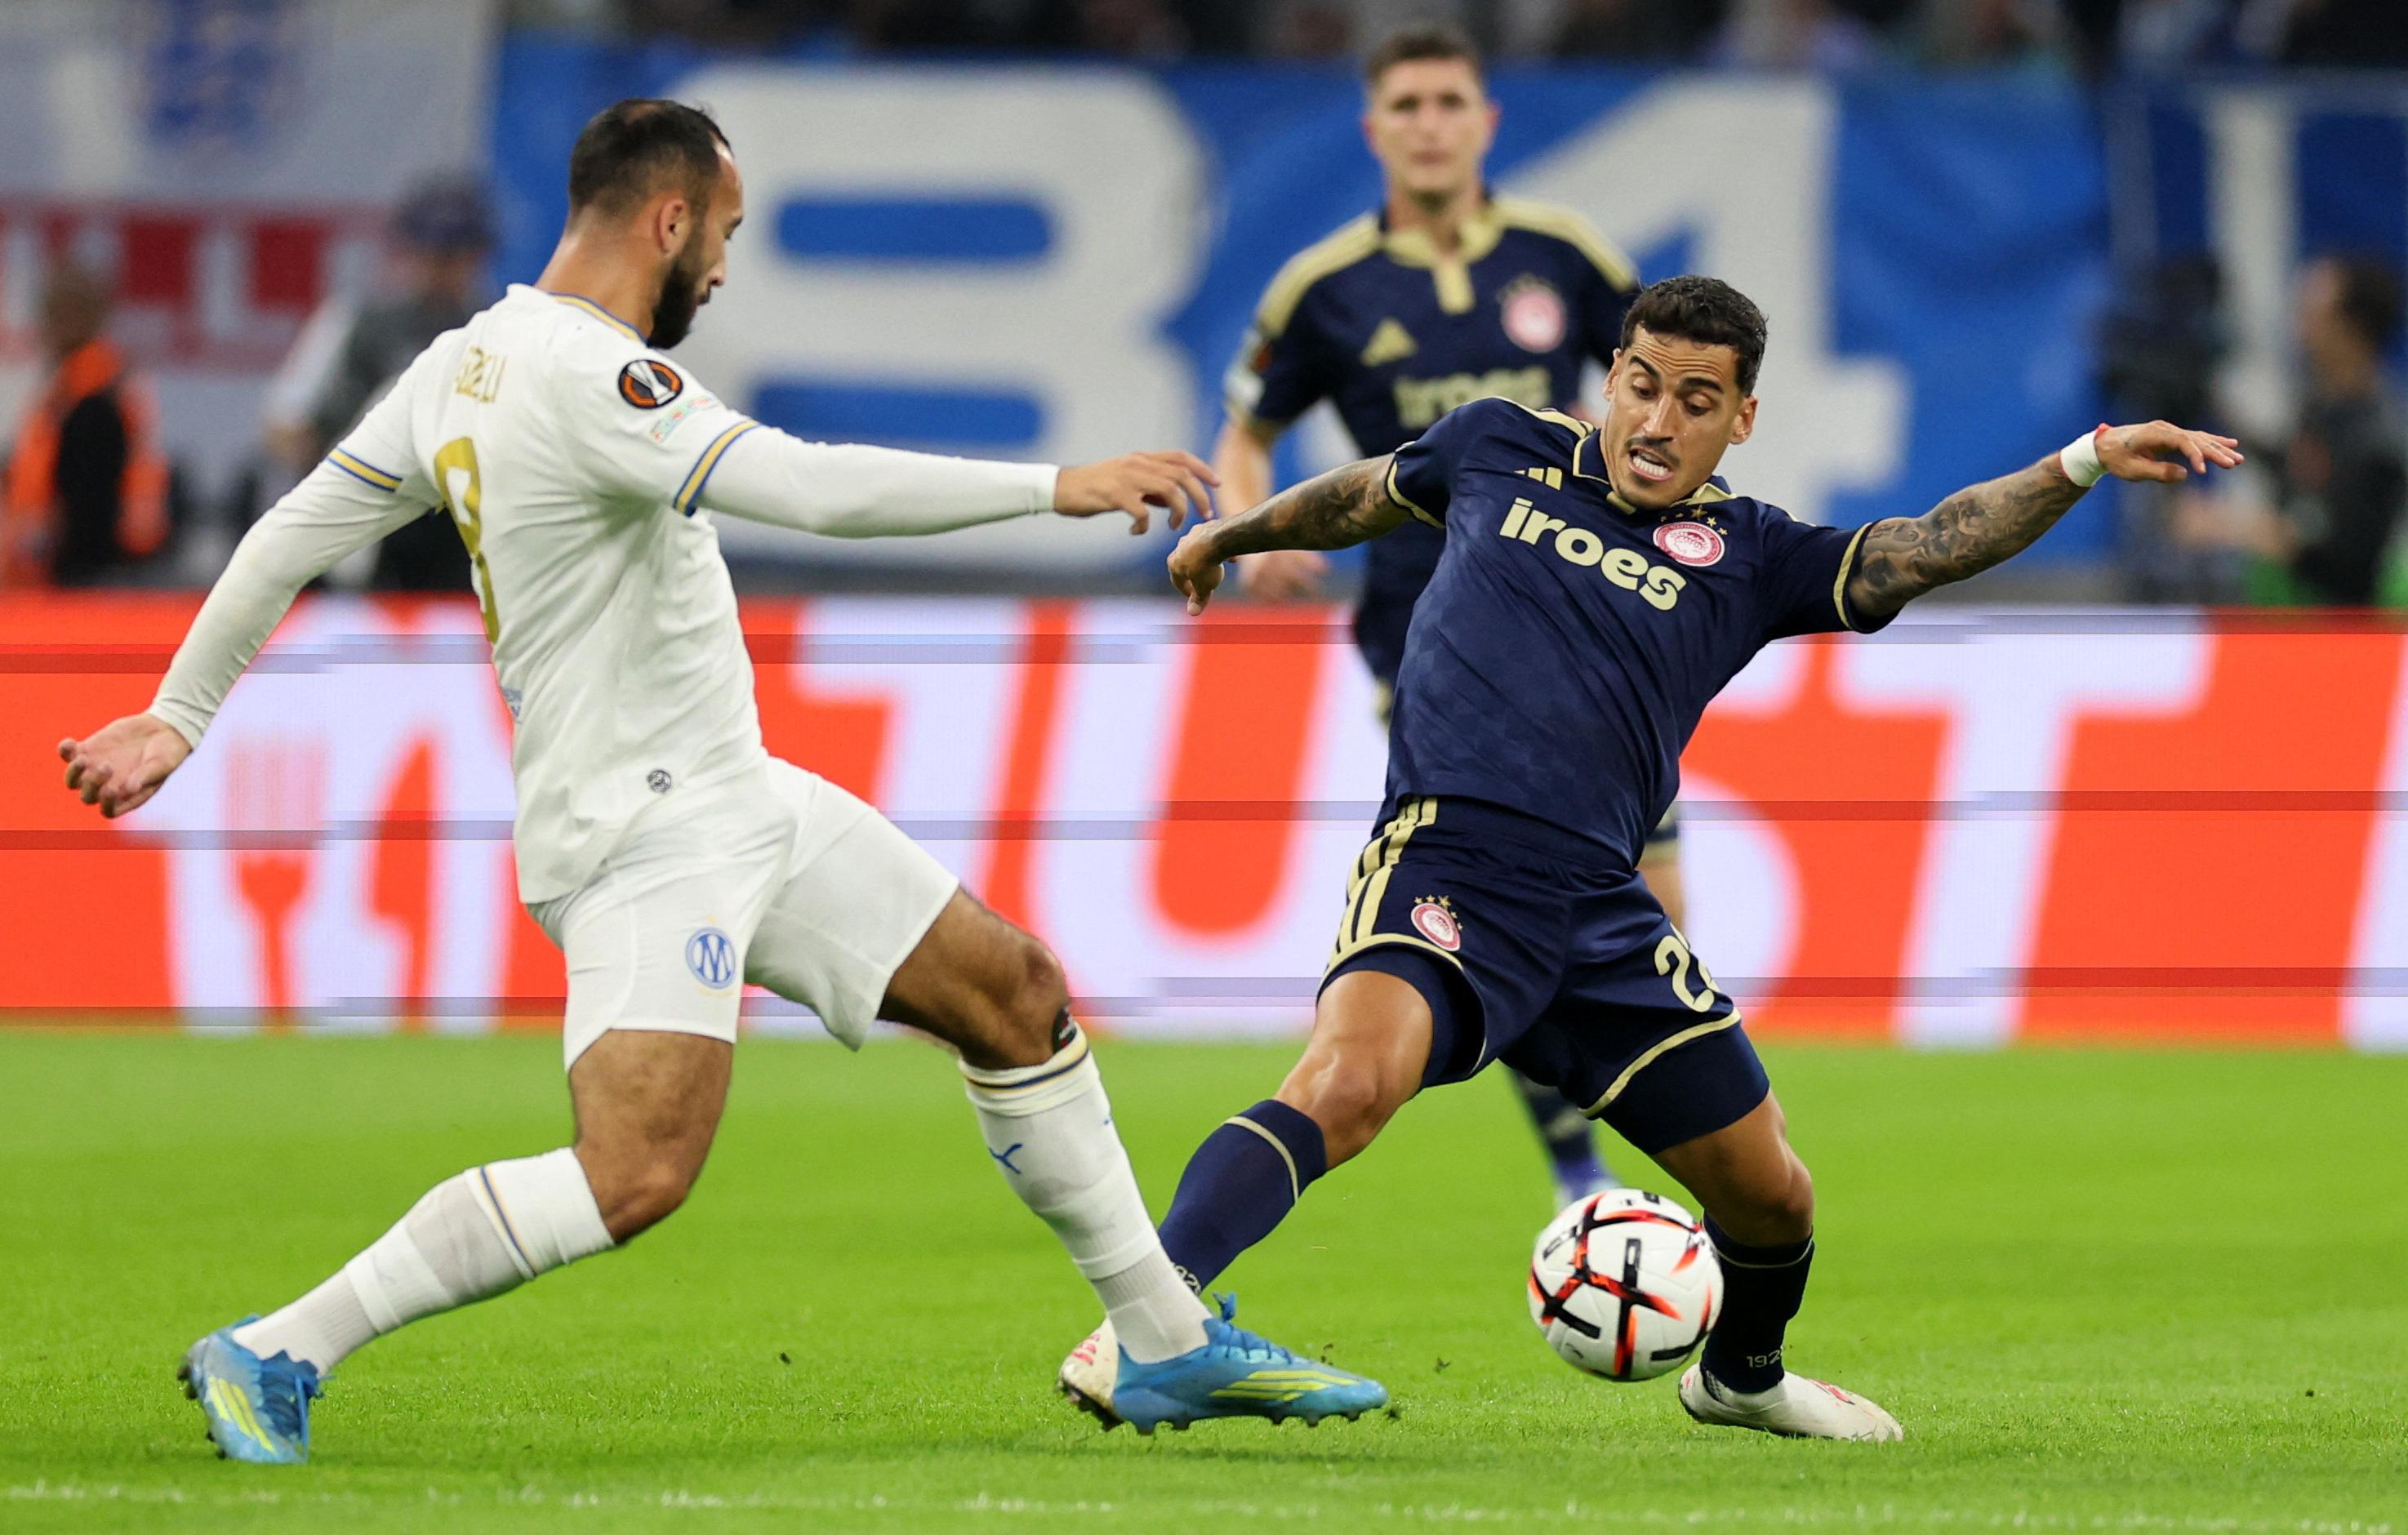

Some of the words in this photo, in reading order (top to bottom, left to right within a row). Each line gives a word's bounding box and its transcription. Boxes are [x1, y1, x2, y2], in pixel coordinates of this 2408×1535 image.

[1499, 496, 1688, 612] iroes
[1654, 922, 1720, 1013] 2
[1746, 1346, 1785, 1368] 192
